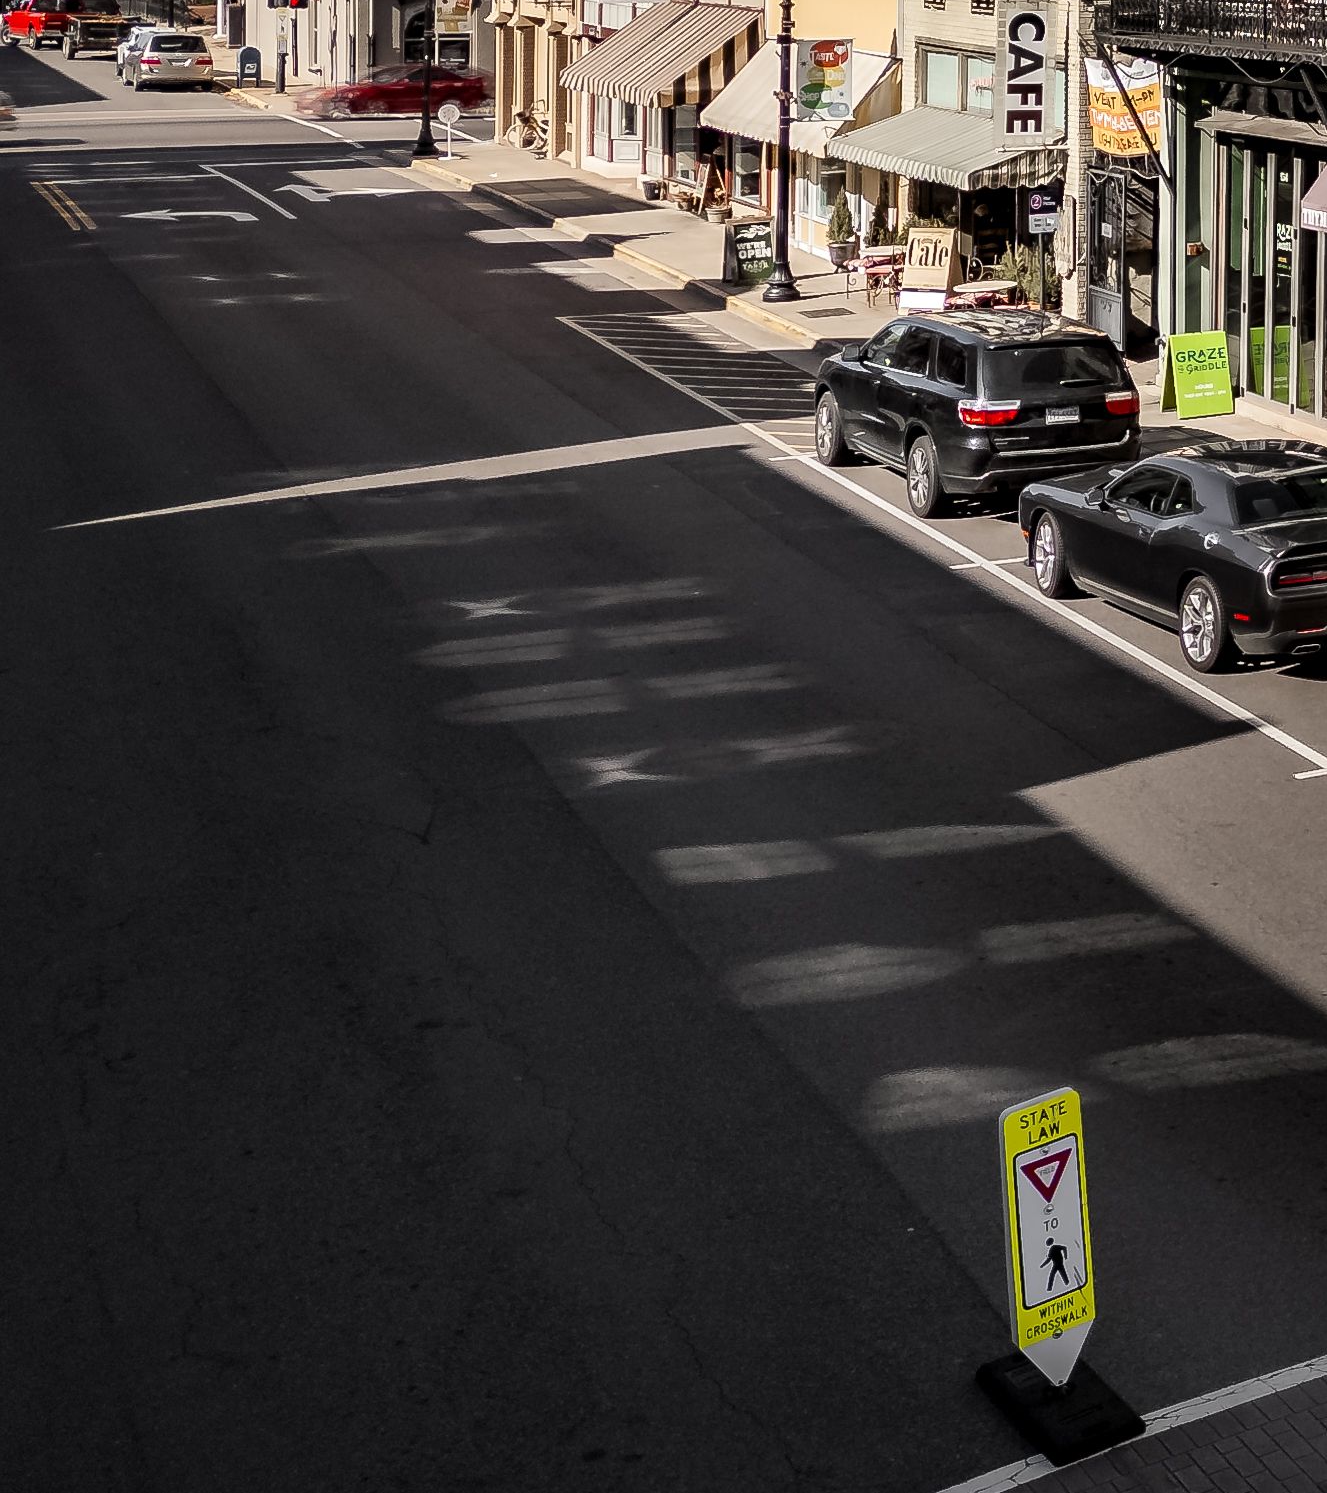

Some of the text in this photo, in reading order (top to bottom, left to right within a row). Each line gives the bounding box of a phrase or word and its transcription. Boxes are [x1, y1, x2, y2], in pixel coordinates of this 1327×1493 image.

[1006, 12, 1046, 134] CAFE
[1032, 196, 1040, 208] 2
[739, 247, 772, 259] OPEN
[908, 237, 949, 268] Cafe
[1176, 346, 1226, 363] GRAZE
[1186, 361, 1227, 375] GRIDDLE
[1019, 1100, 1068, 1130] STATE
[1028, 1123, 1061, 1146] LAW
[1043, 1217, 1059, 1232] TO
[1038, 1296, 1075, 1319] WITHIN
[1026, 1305, 1088, 1340] CROSSWALK
